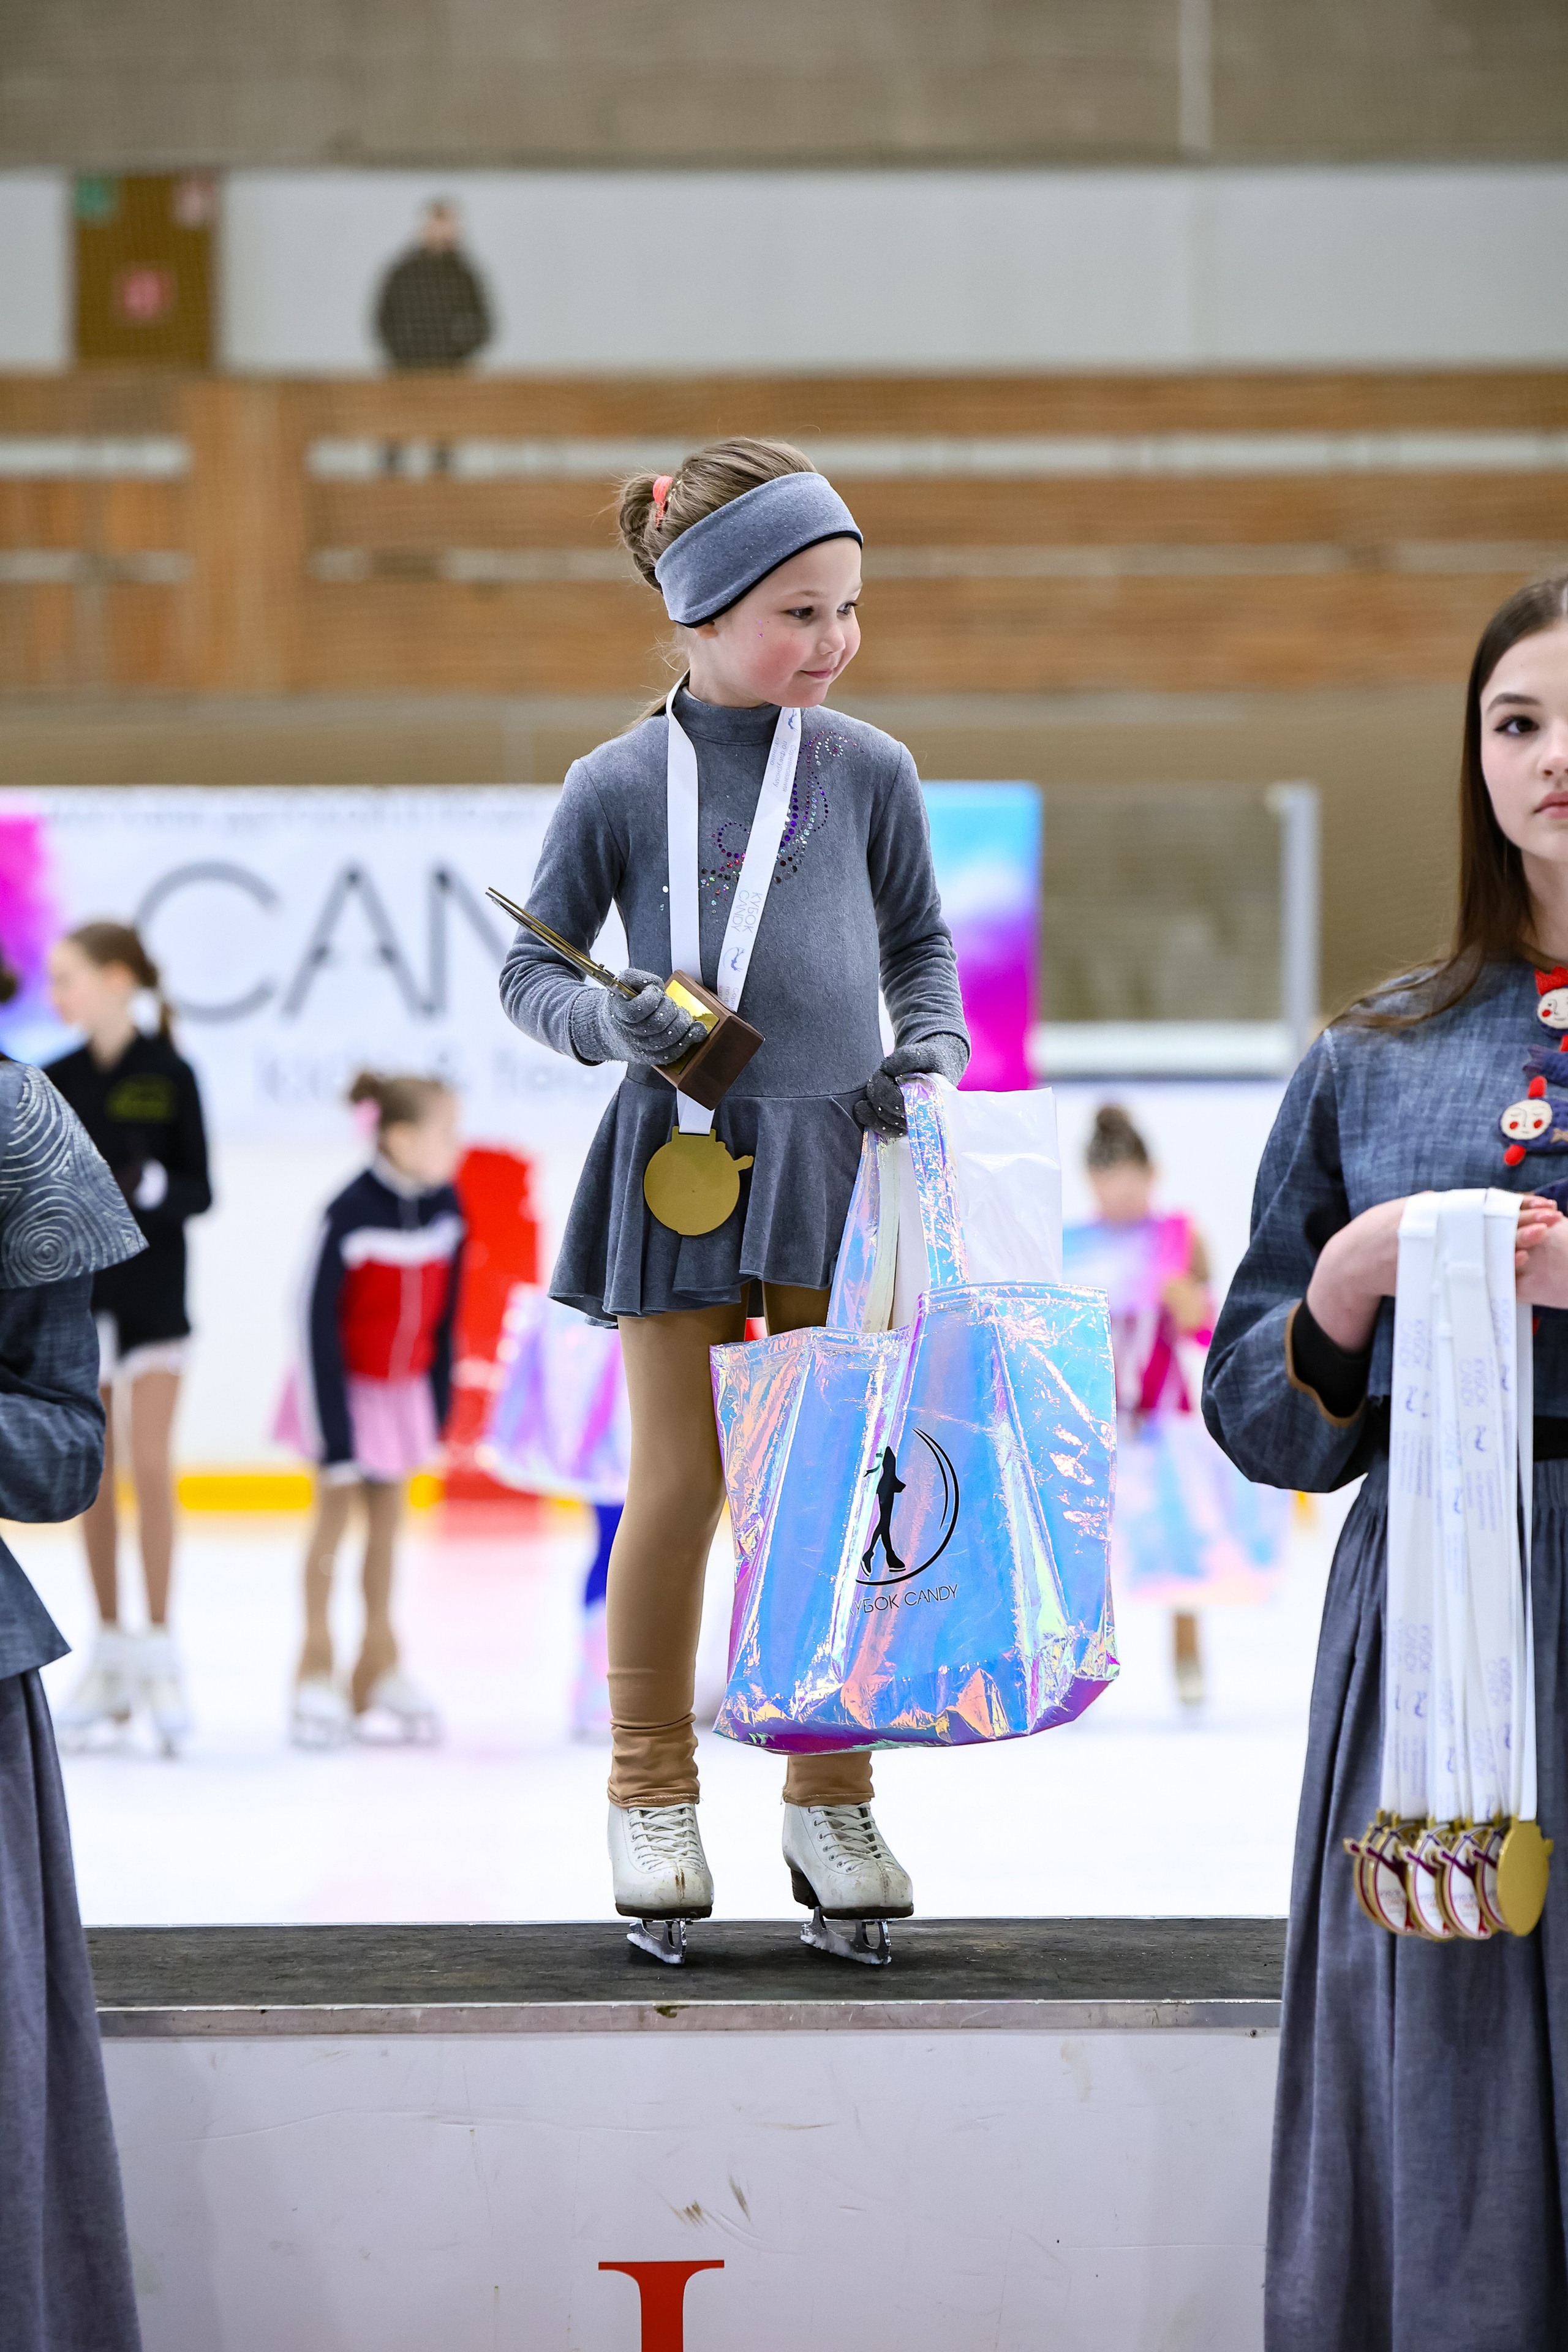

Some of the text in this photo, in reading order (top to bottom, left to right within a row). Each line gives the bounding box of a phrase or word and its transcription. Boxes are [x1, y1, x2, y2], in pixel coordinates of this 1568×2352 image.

[770, 736, 780, 766] катанию
[772, 741, 788, 788] по фигурному
[782, 744, 796, 792] Соревнования
[731, 890, 750, 932] CANDY
[742, 892, 763, 933] КУБОК
[904, 1583, 958, 1607] CANDY
